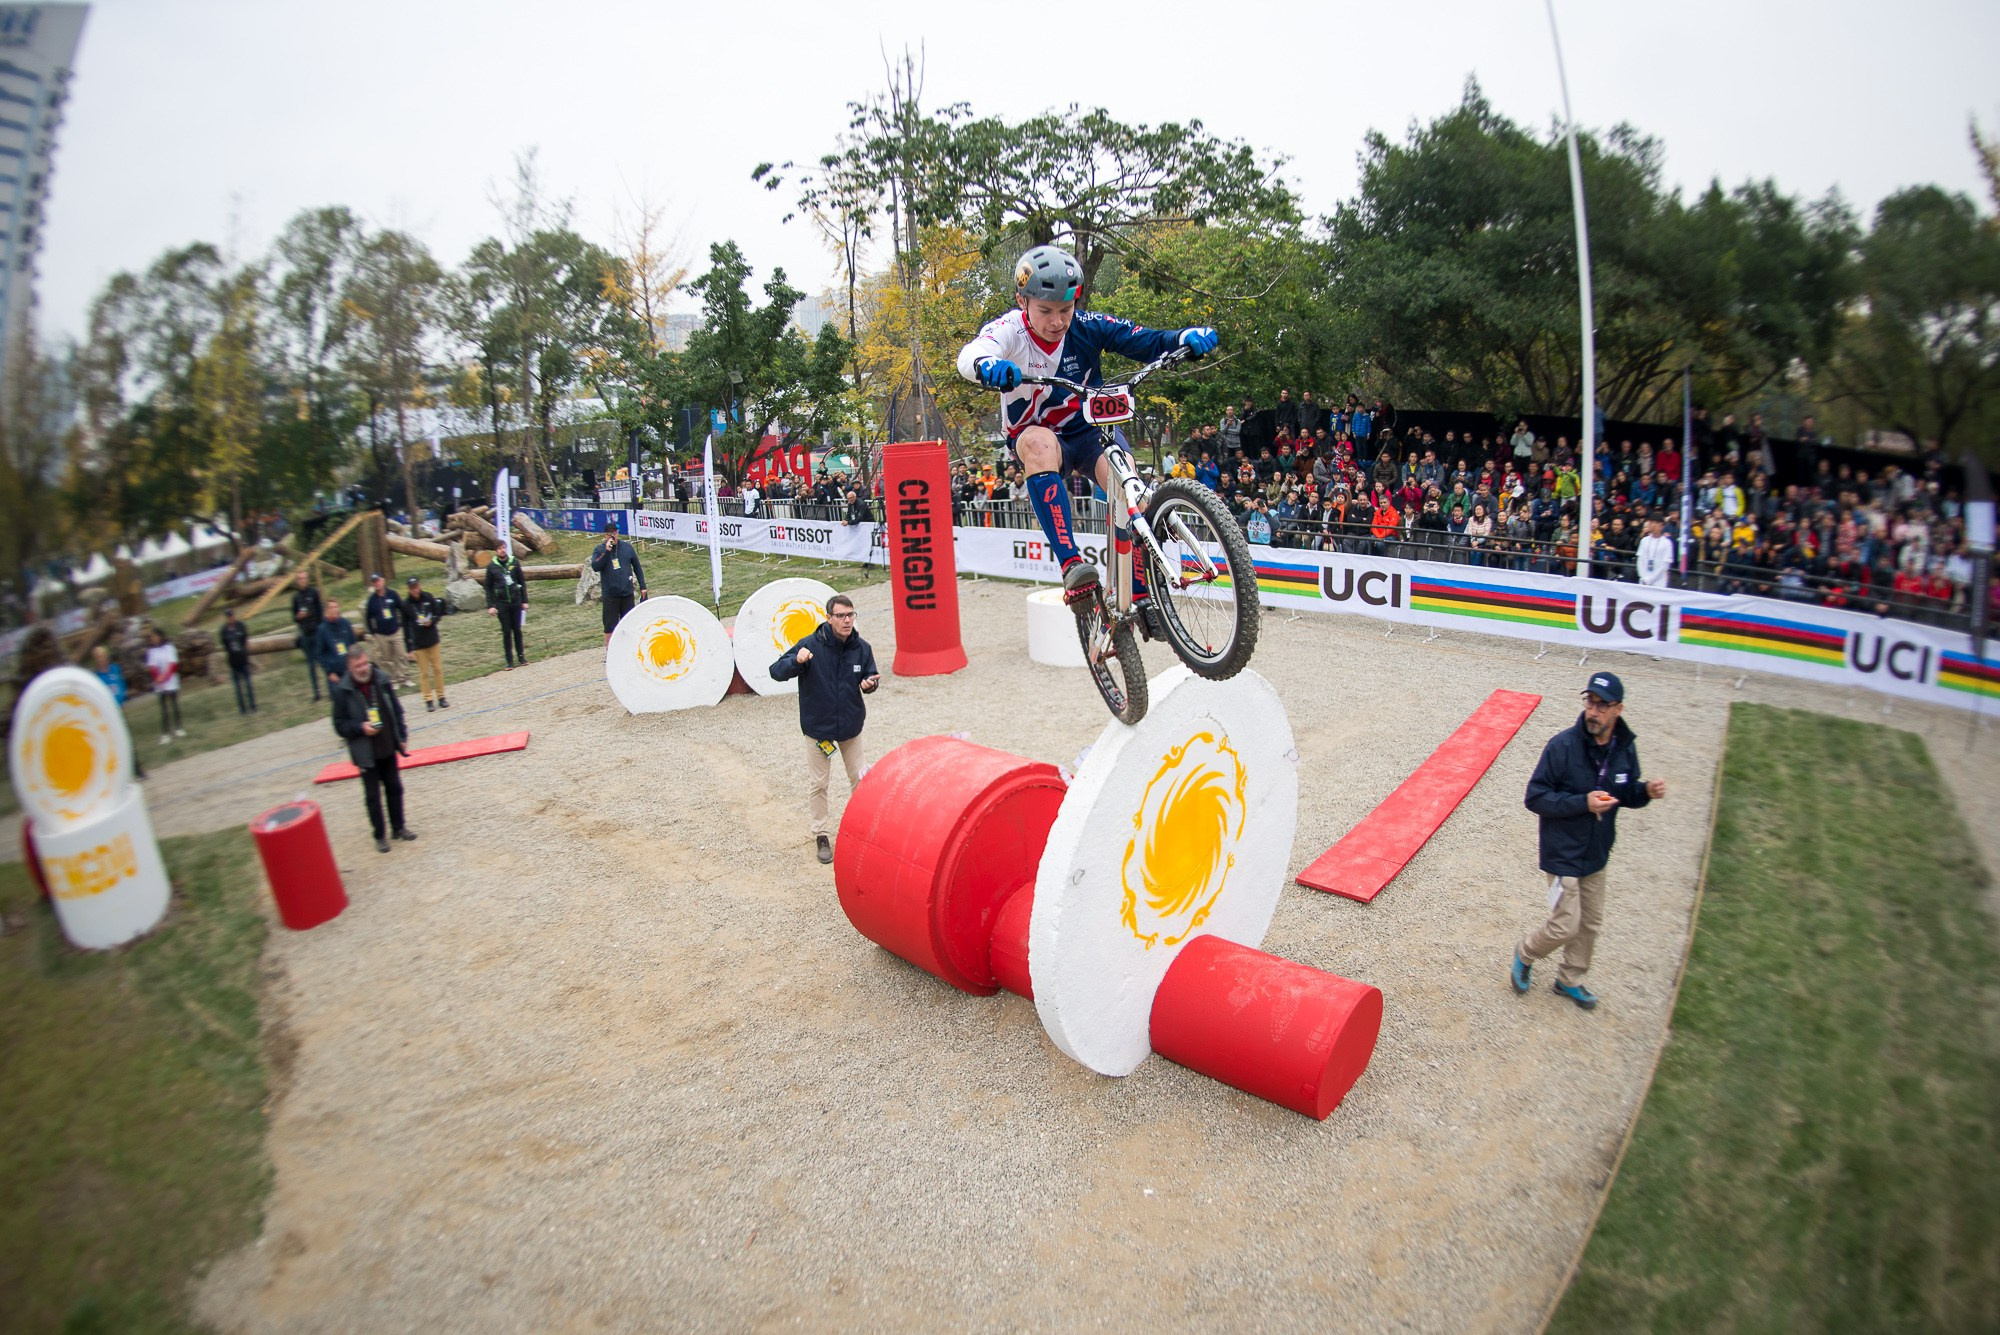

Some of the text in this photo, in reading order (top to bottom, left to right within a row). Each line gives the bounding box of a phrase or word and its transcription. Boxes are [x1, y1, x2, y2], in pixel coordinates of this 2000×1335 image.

[1092, 397, 1128, 417] 305
[898, 479, 937, 611] CHENGDU
[1323, 565, 1402, 608] UCI
[1581, 594, 1671, 642] UCI
[1852, 631, 1932, 684] UCI
